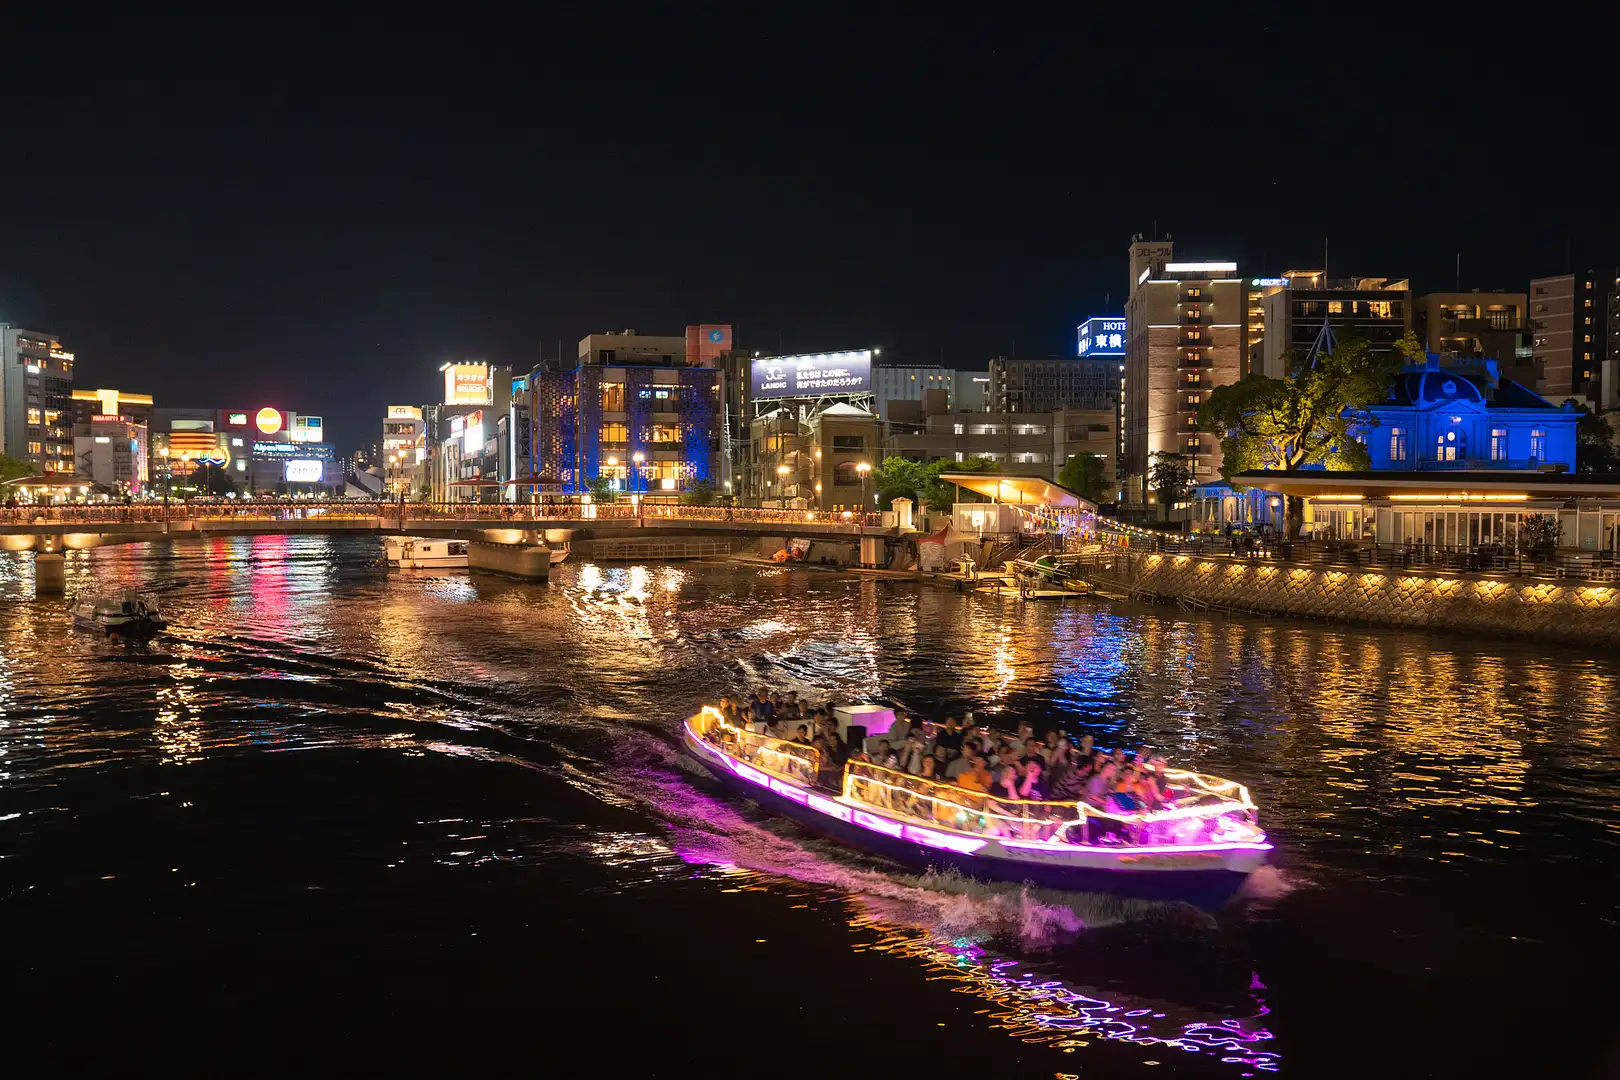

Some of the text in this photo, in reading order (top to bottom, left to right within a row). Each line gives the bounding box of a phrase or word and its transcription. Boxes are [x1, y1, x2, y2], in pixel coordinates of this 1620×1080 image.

[1136, 247, 1171, 257] フローラル
[1095, 333, 1127, 348] 東横
[456, 374, 486, 382] カラオケ
[796, 369, 822, 380] 私たちは
[761, 382, 787, 390] LANDIC
[253, 443, 276, 453] Alpen
